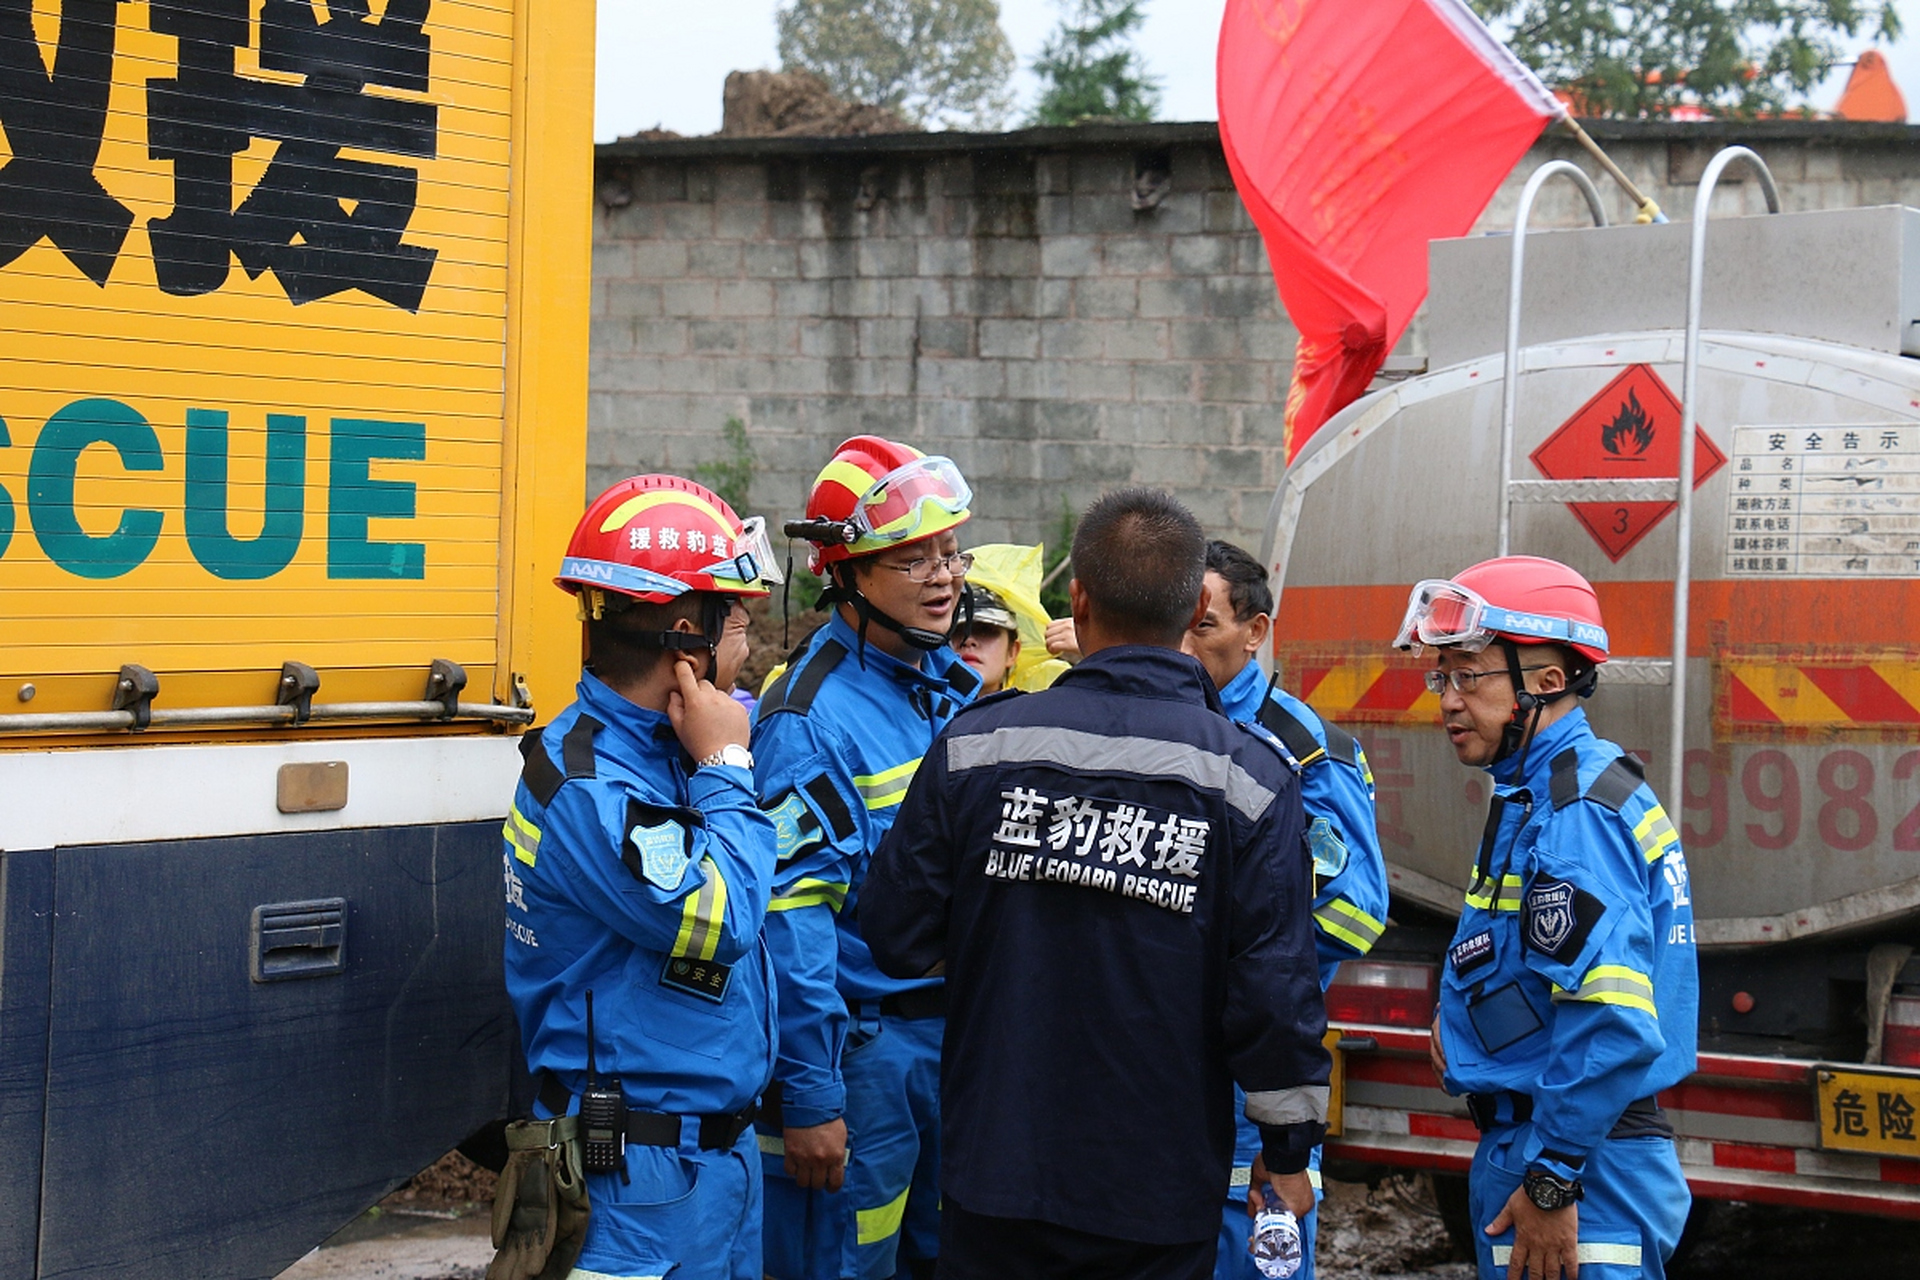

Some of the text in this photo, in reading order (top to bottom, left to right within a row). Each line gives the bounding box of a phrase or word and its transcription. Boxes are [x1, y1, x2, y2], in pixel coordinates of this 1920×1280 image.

[1769, 432, 1899, 451] 安全告示
[1740, 458, 1793, 471] 品名
[0, 398, 427, 580] CUE
[1612, 508, 1629, 535] 3
[1735, 518, 1790, 531] 联系电话
[993, 787, 1210, 878] 蓝豹救援
[985, 849, 1197, 913] BLUE LEOPARD RESCUE
[1833, 1089, 1917, 1141] 危险
